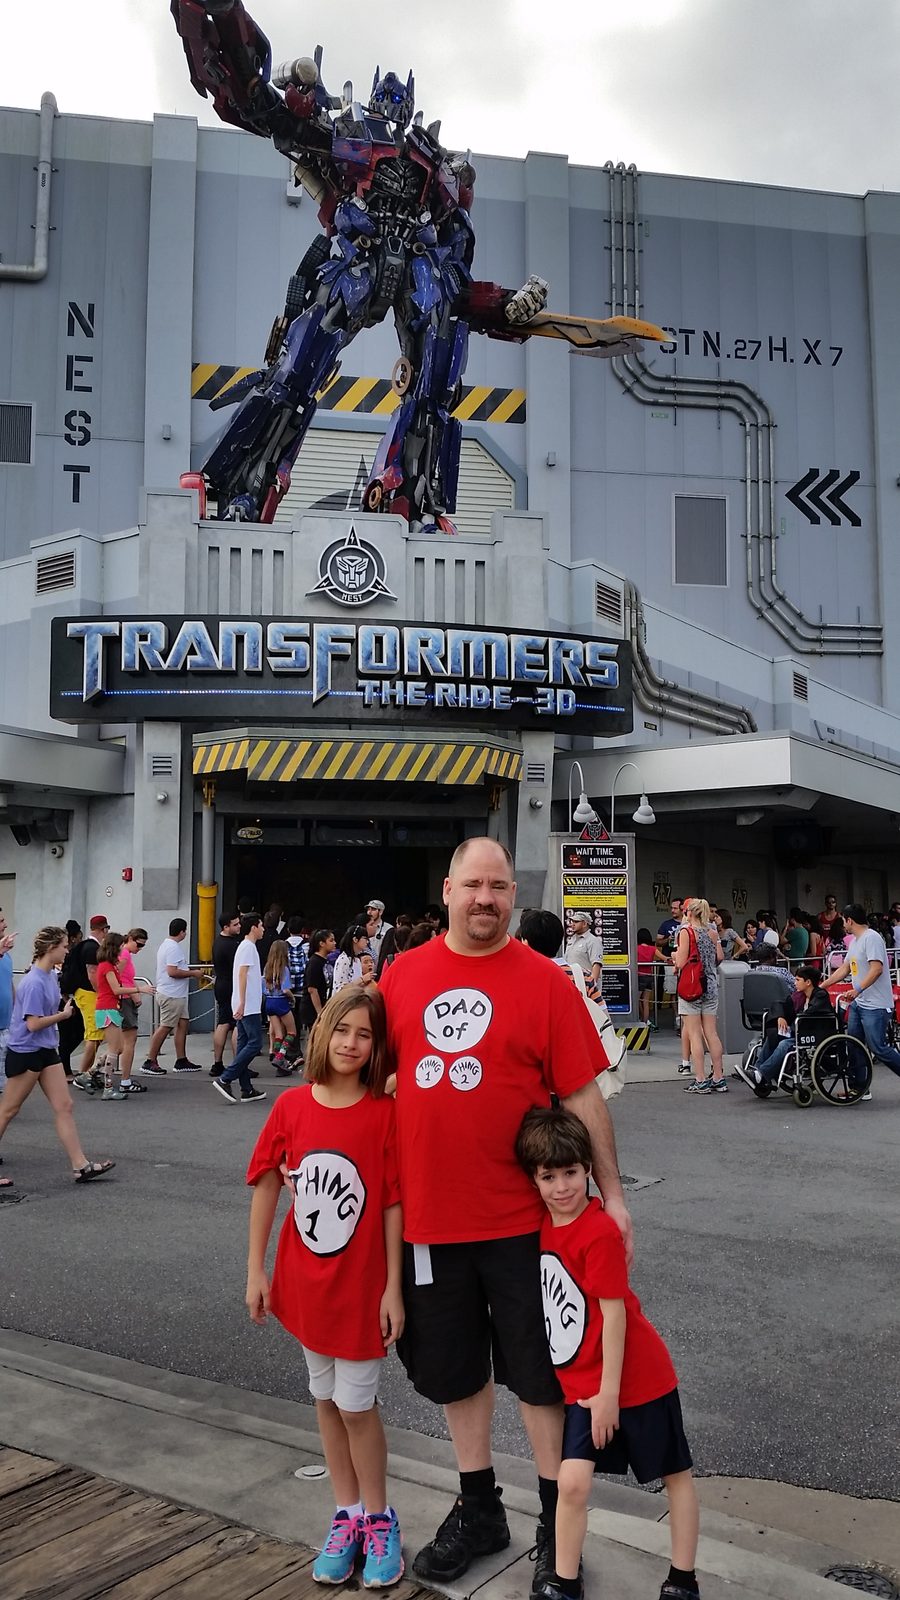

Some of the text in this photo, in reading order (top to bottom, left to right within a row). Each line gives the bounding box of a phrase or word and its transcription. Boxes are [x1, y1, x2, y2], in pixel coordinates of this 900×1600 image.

[63, 301, 95, 503] NEST
[341, 593, 363, 602] NEST
[66, 620, 620, 703] TRANSFORMERS
[357, 679, 428, 707] THE
[575, 847, 614, 856] WAIT TIME
[589, 857, 623, 866] MINUTES
[434, 998, 487, 1019] DAD
[800, 1035, 816, 1044] 500
[419, 1059, 442, 1073] THING
[451, 1061, 480, 1076] THING
[425, 1071, 431, 1081] 1
[461, 1074, 470, 1084] 2
[304, 1209, 321, 1243] 1
